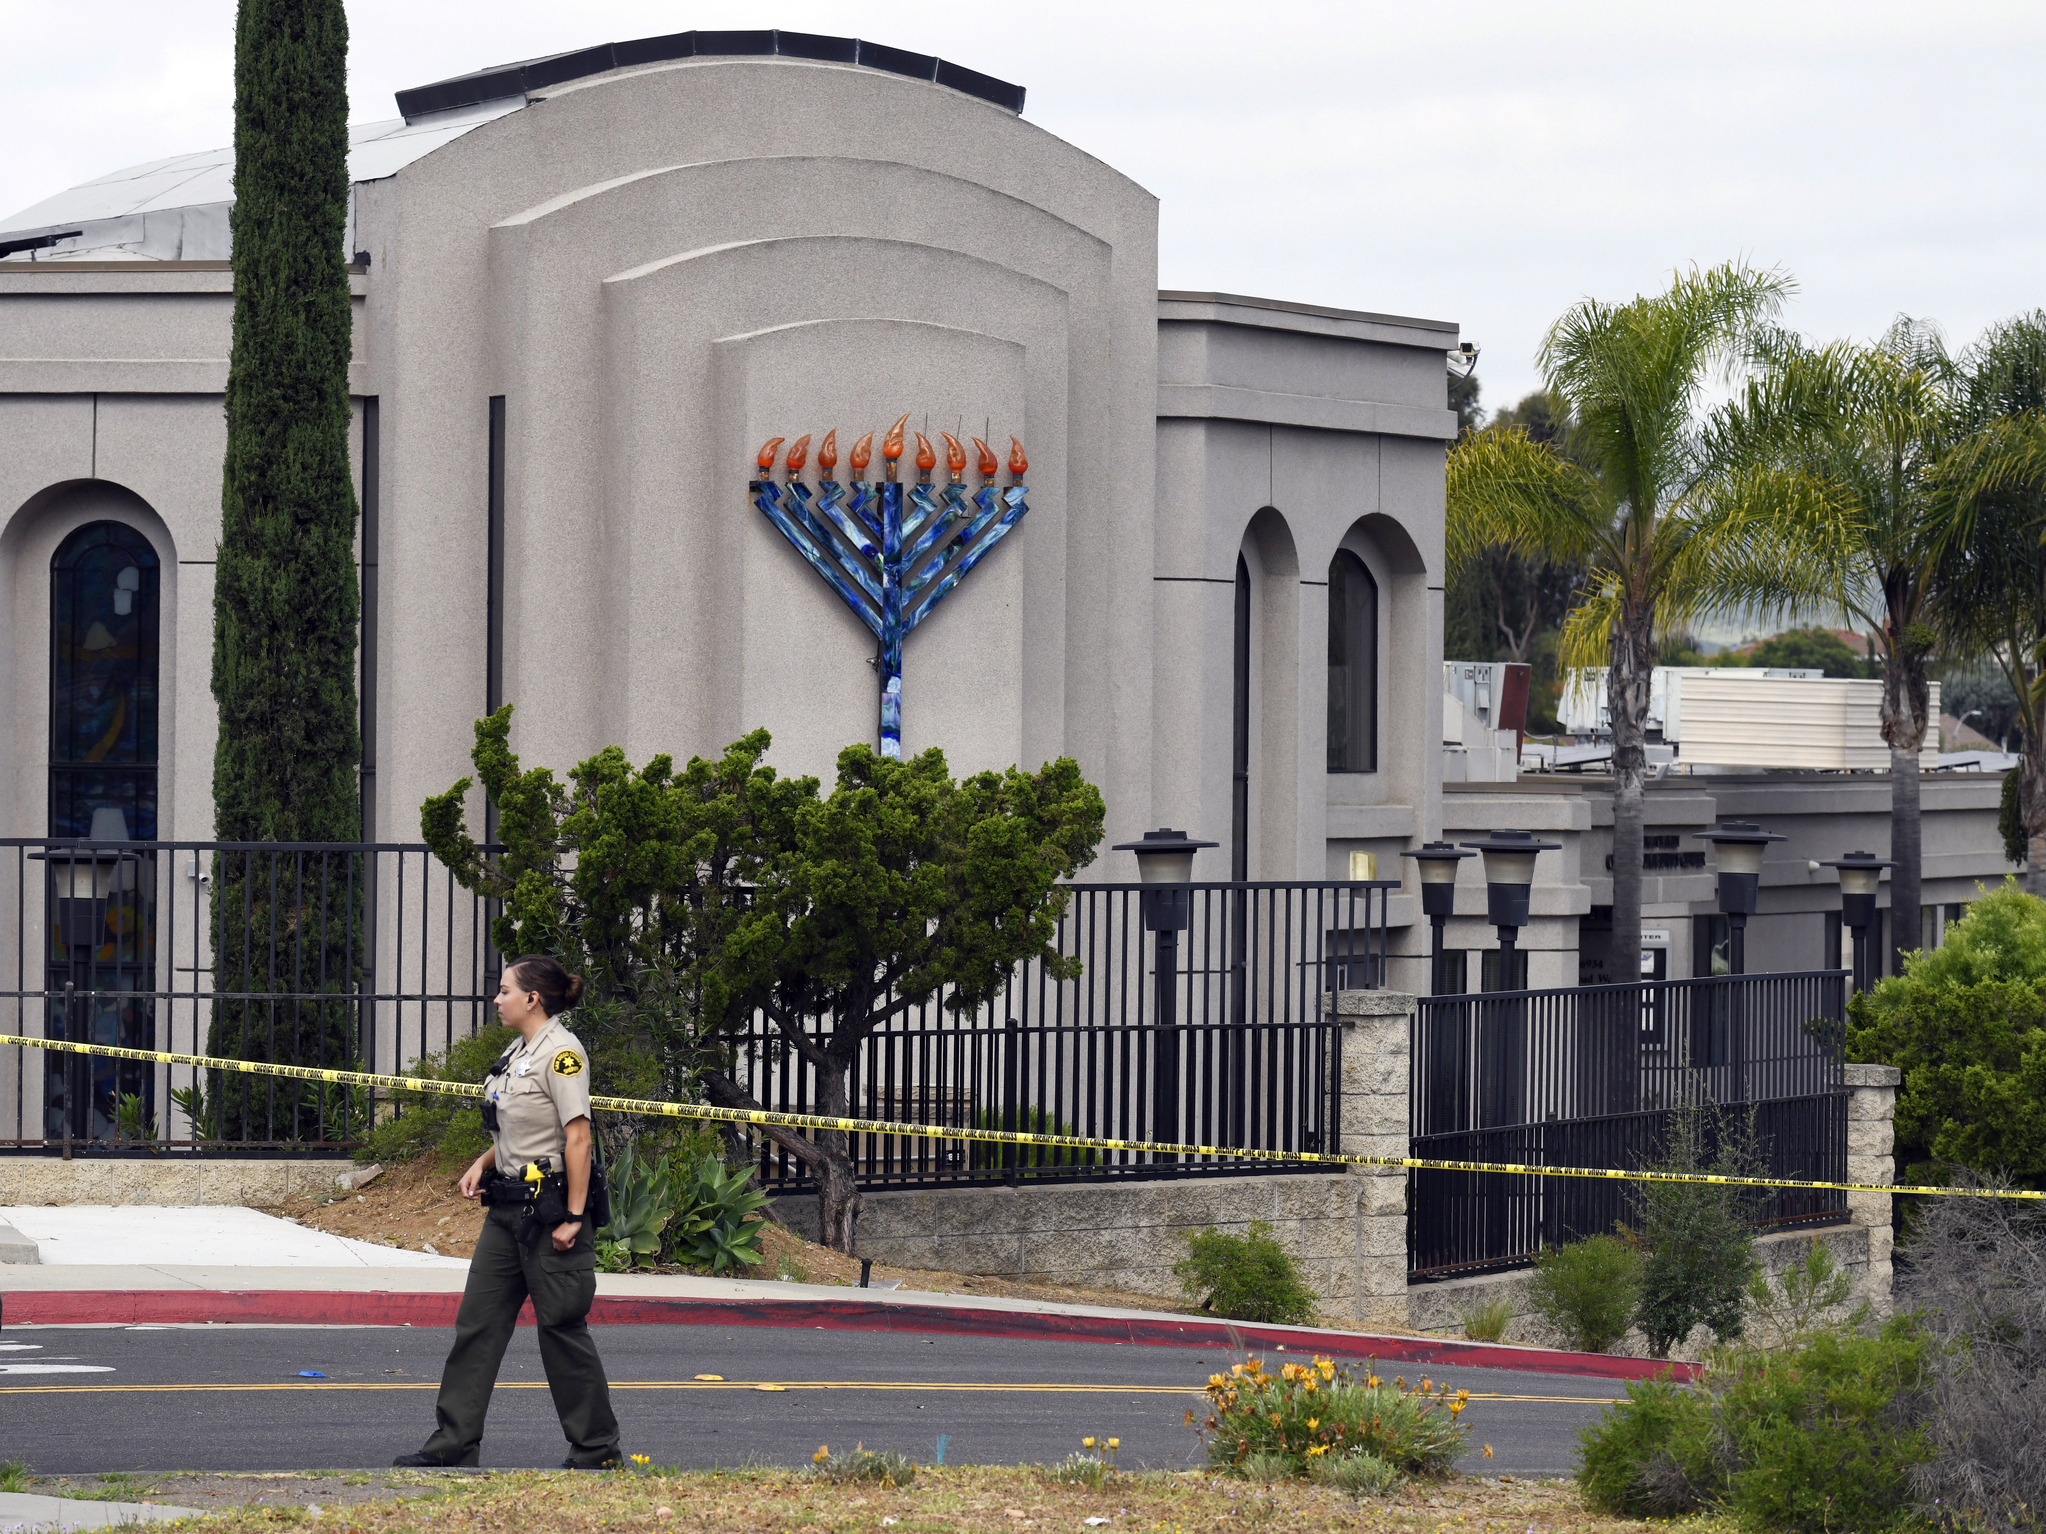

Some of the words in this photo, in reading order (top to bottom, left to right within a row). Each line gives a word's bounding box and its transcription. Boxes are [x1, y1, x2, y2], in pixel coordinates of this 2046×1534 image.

[337, 1072, 358, 1083] SHERIFF
[359, 1075, 370, 1084] LINE
[371, 1076, 378, 1086] DO
[379, 1077, 390, 1087] NOT
[390, 1077, 408, 1089] CROSS
[421, 1080, 442, 1091] SHERIFF
[442, 1083, 454, 1093] LINE
[455, 1084, 463, 1093] DO
[463, 1085, 475, 1094] NOT
[591, 1098, 613, 1108] SHERIFF
[613, 1100, 625, 1109] LINE
[626, 1101, 633, 1110] DO
[634, 1102, 646, 1111] NOT
[646, 1103, 664, 1113] CROSS
[678, 1105, 700, 1116] SHERIFF
[700, 1107, 712, 1117] LINE
[713, 1108, 721, 1118] DO
[722, 1109, 732, 1119] NOT
[733, 1110, 751, 1121] CROSS
[765, 1113, 786, 1124] SHERIFF
[787, 1115, 800, 1125] LINE
[800, 1116, 808, 1126] DO
[809, 1116, 820, 1126] NOT
[821, 1118, 839, 1128] CROSS
[853, 1119, 875, 1130] SHERIFF
[876, 1121, 888, 1131] LINE
[889, 1123, 896, 1132] DO
[897, 1123, 908, 1133] NOT
[909, 1125, 927, 1134] CROSS
[942, 1127, 964, 1137] SHERIFF
[965, 1129, 977, 1137] LINE
[978, 1130, 986, 1139] DO
[987, 1130, 998, 1139] NOT
[999, 1132, 1017, 1141] CROSS
[1032, 1134, 1054, 1143] SHERIFF
[1055, 1136, 1068, 1144] LINE
[1069, 1137, 1077, 1145] DO
[1077, 1137, 1089, 1146] NOT
[1090, 1138, 1108, 1147] CROSS
